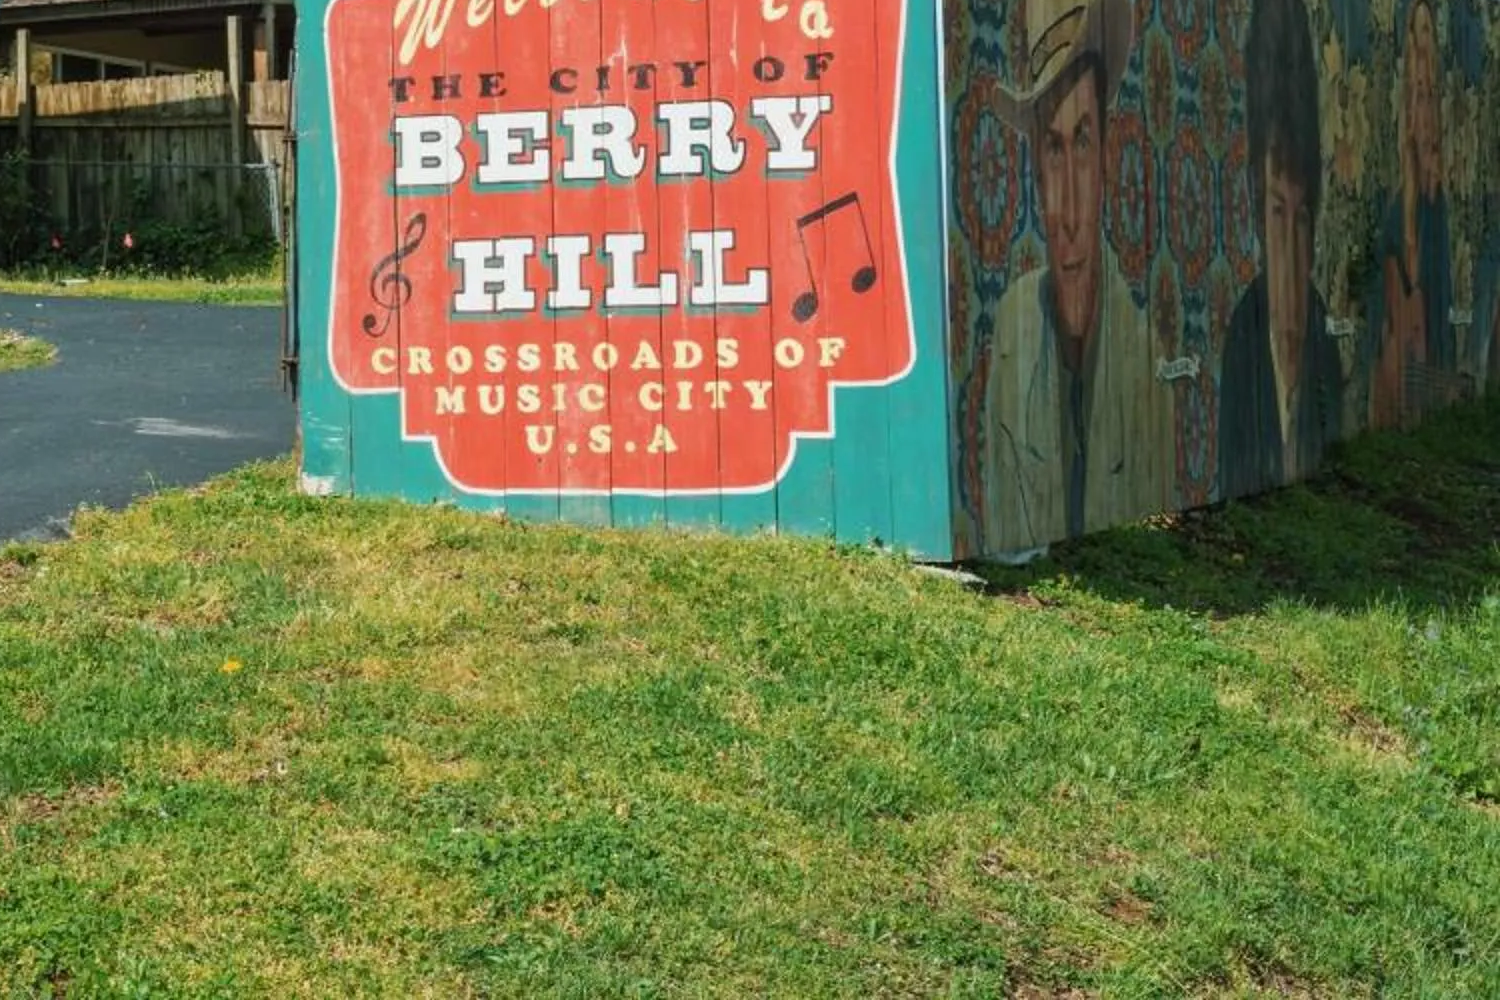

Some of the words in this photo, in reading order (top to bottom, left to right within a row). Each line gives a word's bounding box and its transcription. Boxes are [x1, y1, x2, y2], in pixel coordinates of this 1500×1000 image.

[388, 71, 508, 102] THE
[548, 60, 707, 94] CITY
[753, 52, 836, 84] OF
[391, 94, 833, 188] BERRY
[450, 229, 770, 314] HILL
[370, 338, 741, 376] CROSSROADS
[774, 336, 847, 369] OF
[435, 383, 607, 415] MUSIC
[638, 379, 774, 411] CITY
[525, 422, 678, 456] U.S.A
